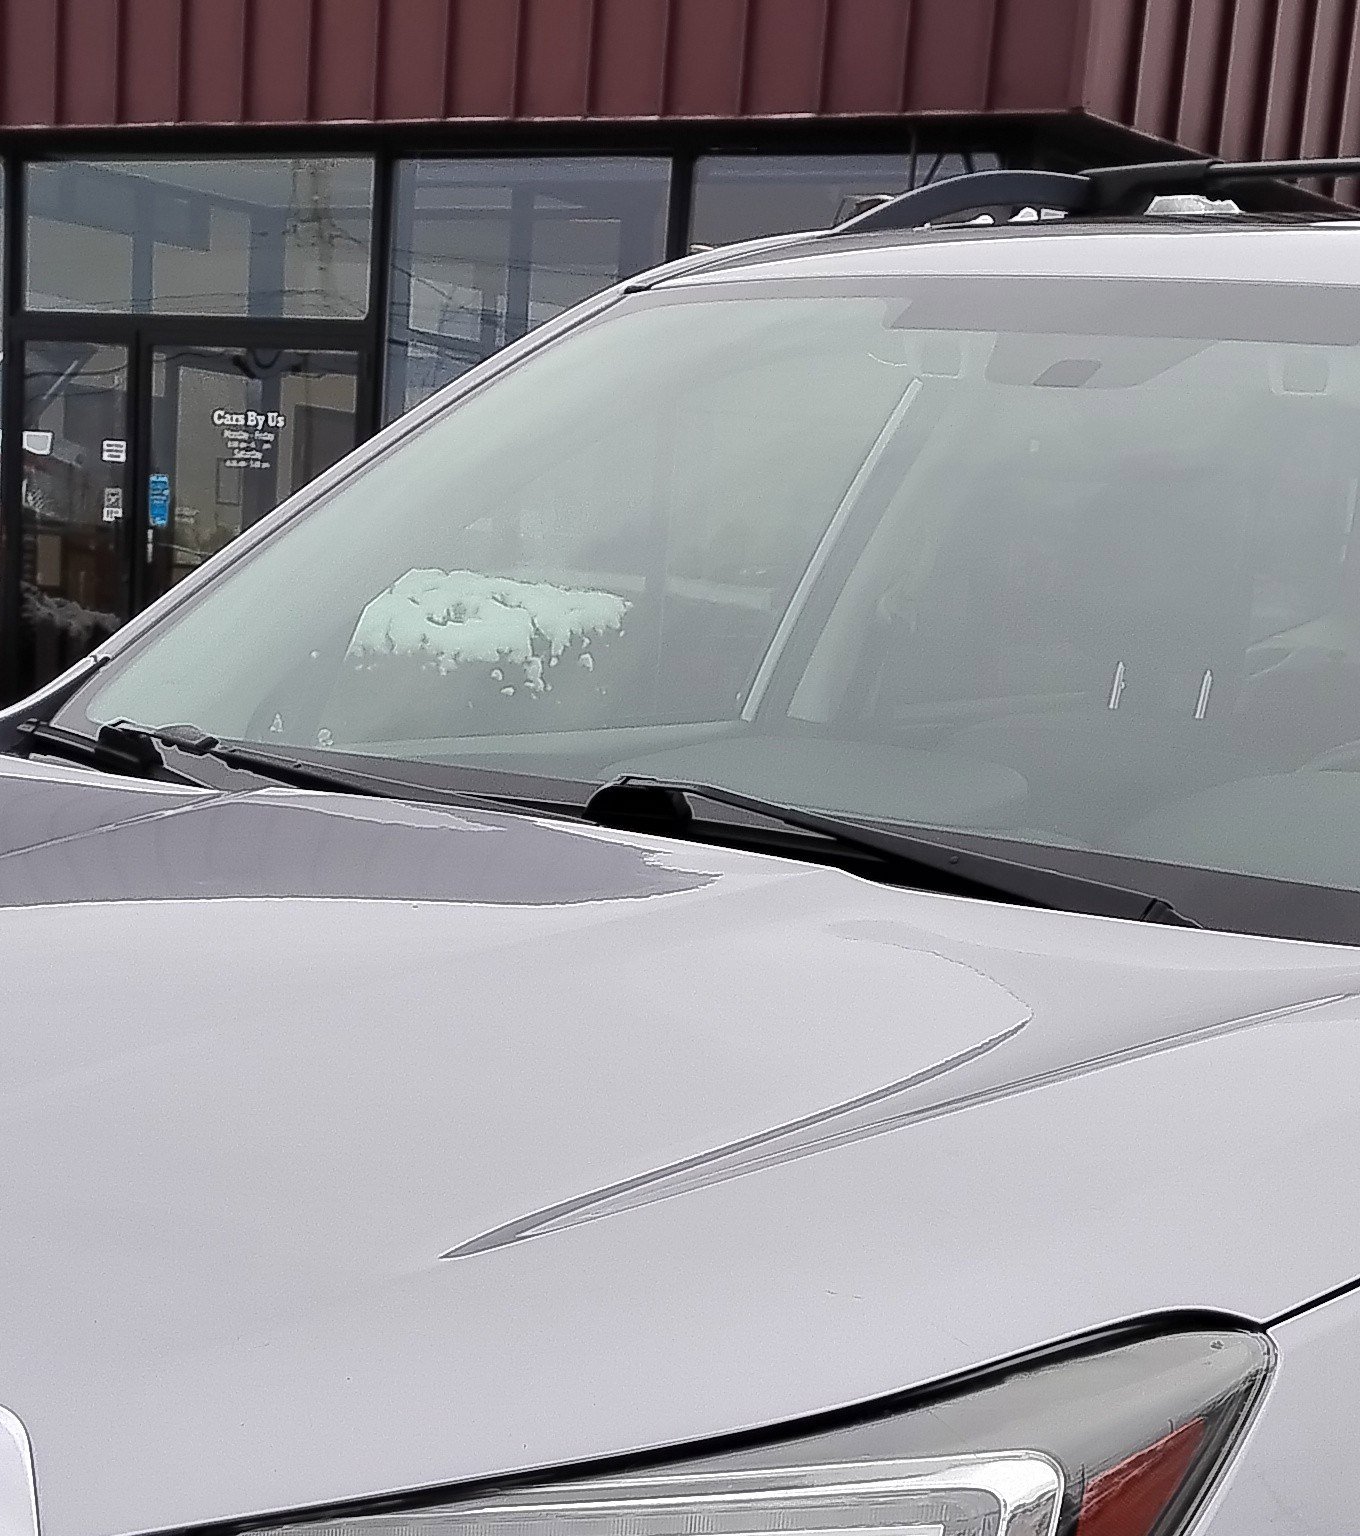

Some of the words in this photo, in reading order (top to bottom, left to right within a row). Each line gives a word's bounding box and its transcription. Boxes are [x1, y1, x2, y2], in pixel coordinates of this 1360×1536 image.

[213, 410, 245, 425] Cars
[247, 411, 265, 430] By
[267, 412, 285, 428] Us
